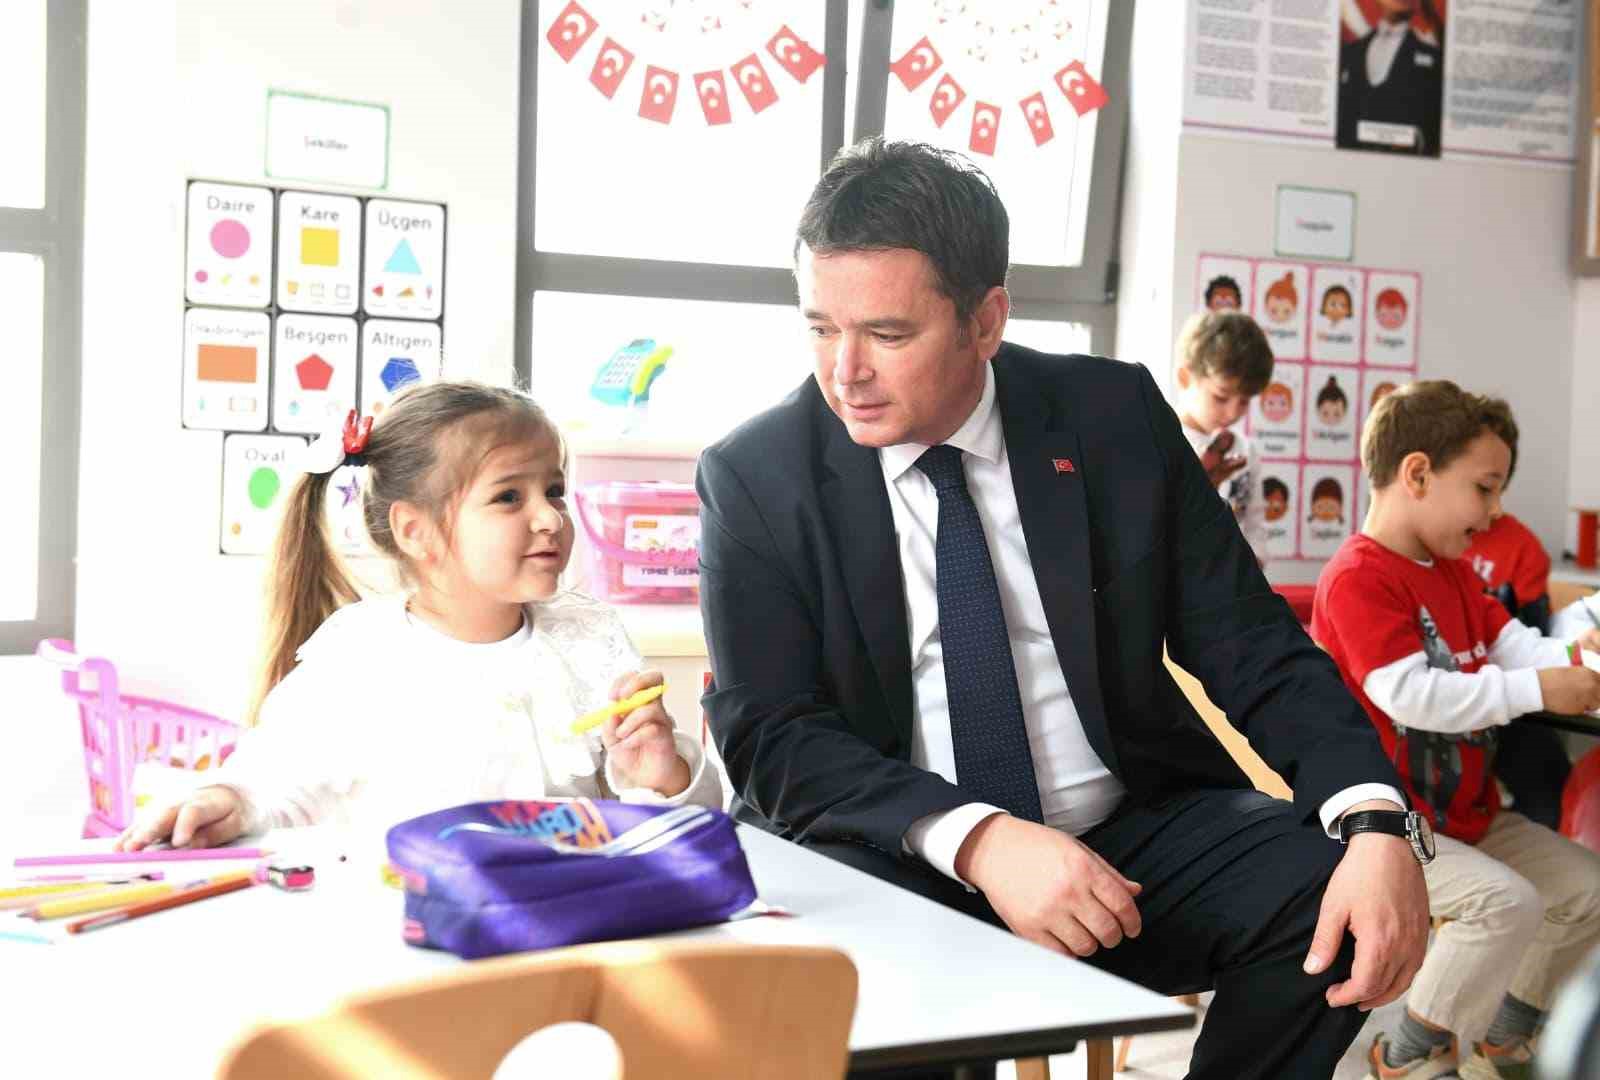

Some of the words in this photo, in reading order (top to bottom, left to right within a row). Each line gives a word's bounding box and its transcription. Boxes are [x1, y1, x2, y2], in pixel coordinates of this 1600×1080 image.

[207, 196, 255, 213] Daire
[300, 205, 340, 222] Kare
[378, 211, 432, 232] Üçgen
[284, 327, 348, 345] Beşgen
[244, 448, 285, 463] Oval
